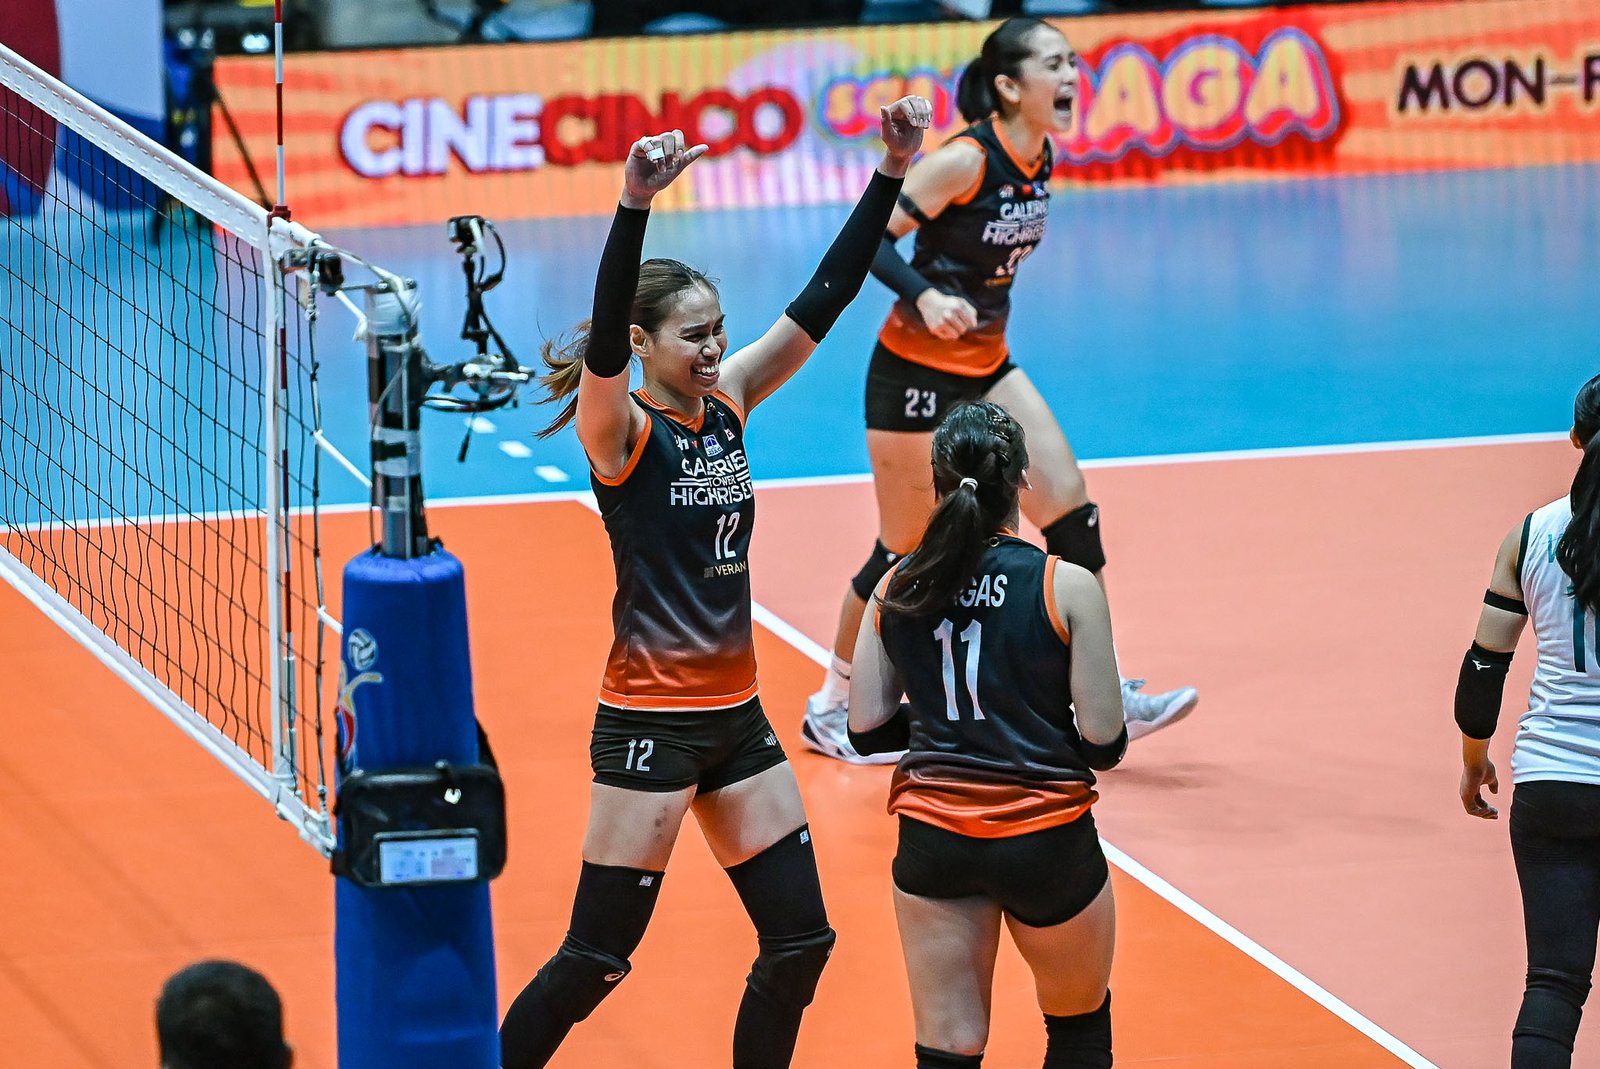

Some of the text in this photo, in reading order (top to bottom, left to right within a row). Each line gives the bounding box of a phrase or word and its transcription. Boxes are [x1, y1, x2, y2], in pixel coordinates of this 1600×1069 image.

[1052, 30, 1341, 162] AGA
[904, 387, 937, 418] 23
[708, 475, 737, 488] TOWER
[714, 511, 741, 560] 12
[955, 574, 1008, 607] GAS
[932, 617, 986, 721] 11
[625, 738, 654, 772] 12
